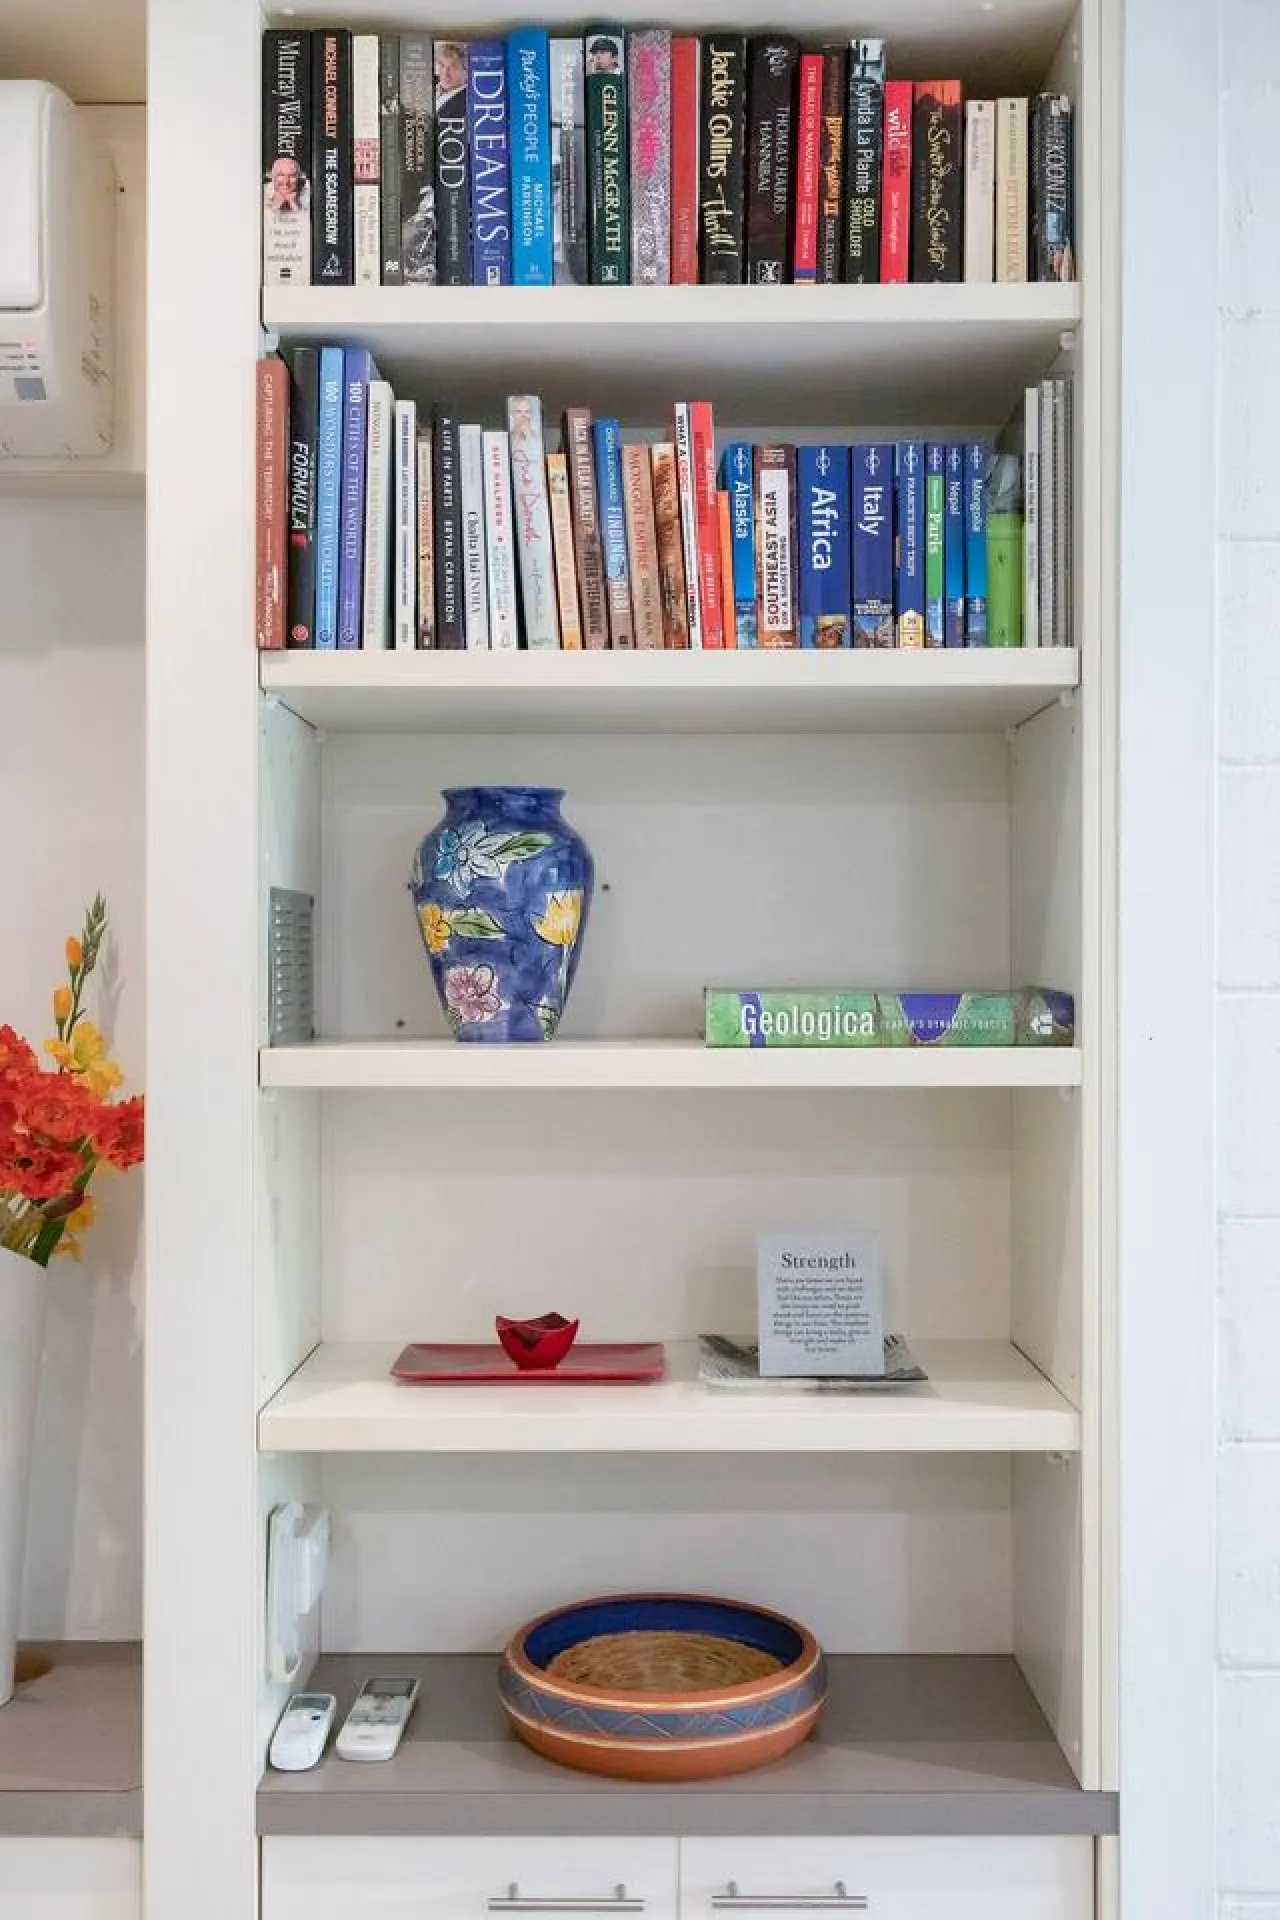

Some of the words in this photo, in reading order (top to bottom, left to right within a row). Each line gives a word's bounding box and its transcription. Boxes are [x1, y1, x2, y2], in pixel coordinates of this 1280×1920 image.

[272, 40, 300, 99] Murray
[324, 38, 337, 84] MICHAEL
[709, 43, 736, 107] Jackie
[325, 85, 337, 138] CONNELLY
[601, 85, 618, 152] GLENN
[856, 83, 874, 124] Lynda
[278, 100, 301, 156] Walker
[523, 103, 538, 163] PEOPLE
[707, 114, 733, 177] Collins
[775, 107, 789, 163] THOMAS
[857, 129, 873, 144] La
[887, 108, 908, 150] wild
[326, 148, 338, 170] THE
[439, 118, 466, 188] ROD
[473, 70, 508, 241] DREAMS
[758, 122, 772, 191] HANNIBAL
[855, 150, 874, 192] Plante
[773, 168, 787, 214] HARRIS
[1045, 144, 1067, 211] KOONTZ
[325, 173, 338, 244] SCARECROW
[522, 176, 533, 246] PARKINSON
[534, 184, 545, 237] MICHAEL
[603, 158, 620, 251] McGRATH
[849, 198, 862, 256] SHOULDER
[864, 198, 874, 226] COLD
[325, 381, 338, 402] 100
[349, 381, 362, 402] 100
[323, 407, 337, 477] WONDERS
[348, 407, 361, 449] CITIES
[441, 417, 449, 425] A
[442, 429, 452, 450] LIFE
[677, 415, 687, 447] WHAT
[264, 441, 274, 460] THE
[347, 454, 361, 471] OF
[443, 457, 452, 469] IN
[264, 465, 274, 519] TERRITORY
[291, 441, 309, 529] FORMULA
[323, 481, 335, 495] OF
[346, 477, 360, 503] THE
[443, 474, 453, 507] PARTS
[948, 481, 960, 515] Nepal
[970, 478, 983, 532] Mongolia
[322, 505, 335, 527] THE
[735, 480, 750, 538] Alaska
[766, 491, 778, 527] ASIA
[812, 486, 839, 570] Africa
[858, 486, 884, 534] Italy
[345, 508, 359, 559] WORLD
[443, 519, 454, 556] BRYAN
[608, 507, 625, 563] FINDING
[928, 511, 942, 554] Paris
[321, 535, 335, 589] WORLD
[469, 553, 481, 572] Hai
[766, 532, 778, 625] SOUTHEAST
[444, 561, 455, 622] CRANSTON
[471, 576, 482, 613] INDIA
[611, 579, 628, 614] GOBI
[740, 1003, 875, 1040] Geologica
[782, 1251, 856, 1270] Strength
